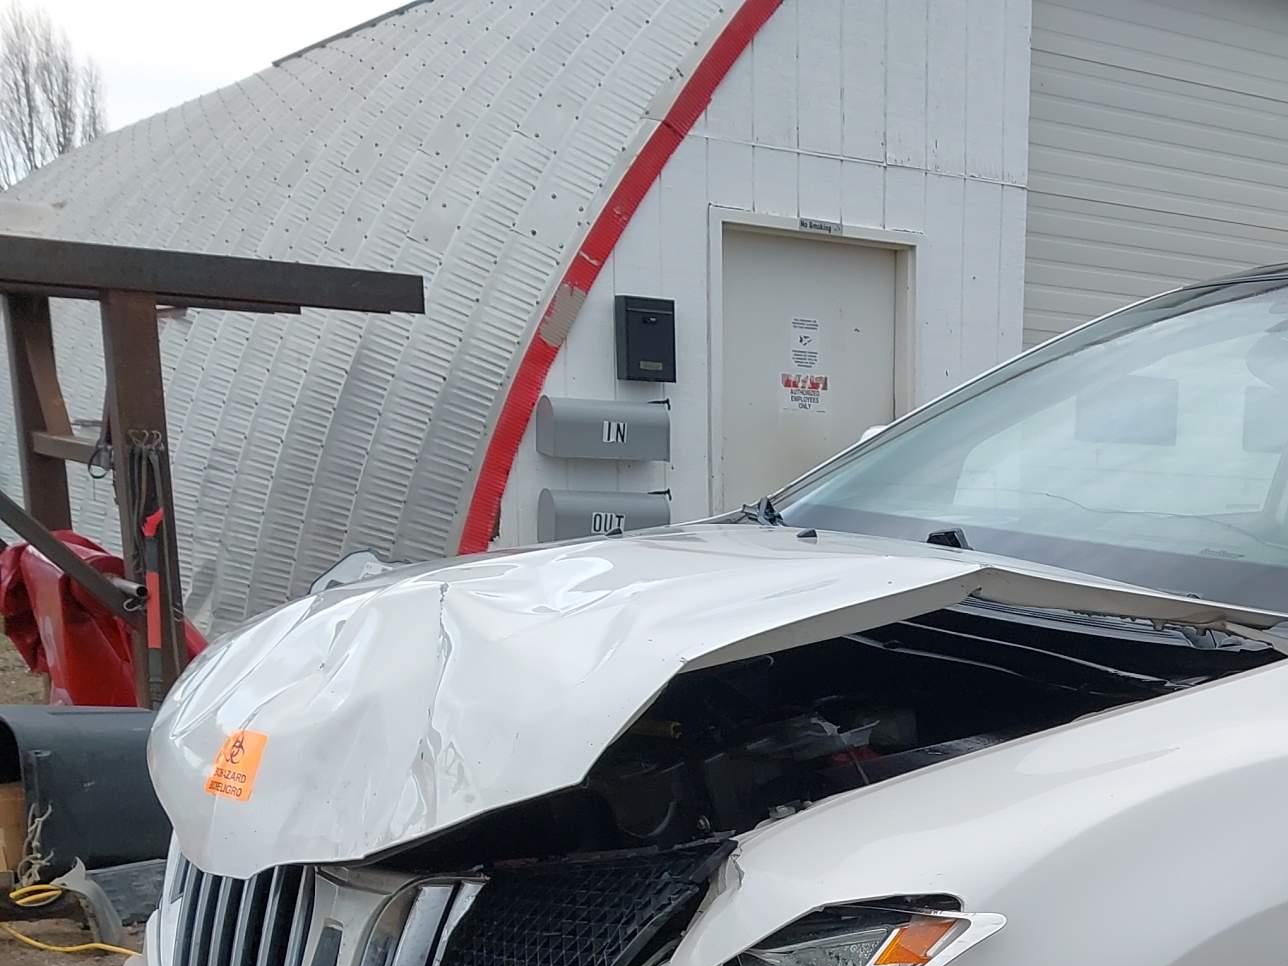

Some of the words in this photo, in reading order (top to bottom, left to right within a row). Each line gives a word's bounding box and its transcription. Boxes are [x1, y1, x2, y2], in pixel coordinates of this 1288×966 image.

[800, 220, 808, 228] No
[810, 221, 832, 233] Smoking
[607, 421, 626, 443] IN
[594, 514, 625, 532] OUT
[208, 780, 242, 797] PELIGRO
